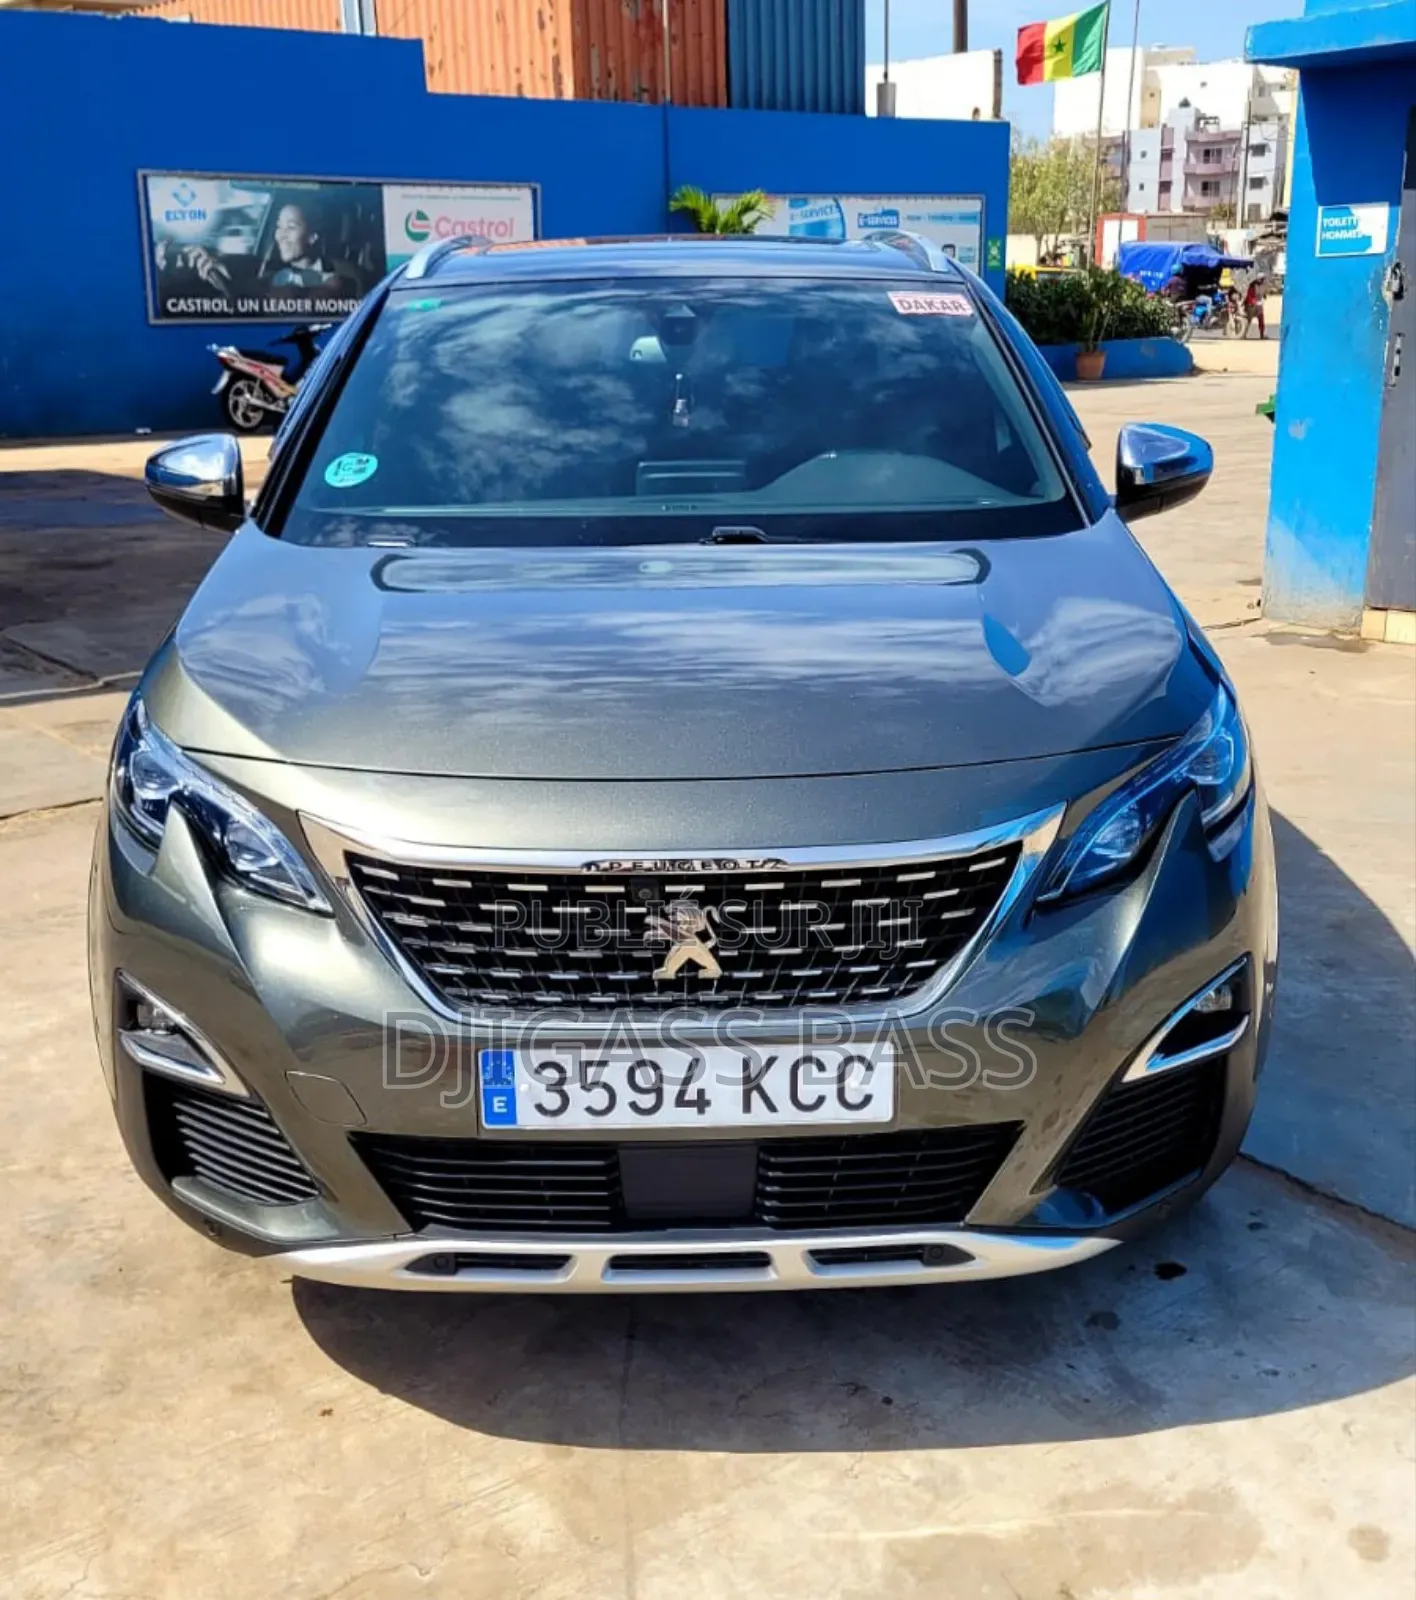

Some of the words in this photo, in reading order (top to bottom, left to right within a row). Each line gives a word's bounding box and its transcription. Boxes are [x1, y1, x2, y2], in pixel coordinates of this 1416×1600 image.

[435, 215, 514, 239] Castrol
[166, 297, 234, 316] CASTROL,
[237, 299, 259, 313] UN
[263, 299, 312, 313] LEADER
[898, 299, 967, 312] DAKAR
[533, 1058, 712, 1118] 3594
[741, 1054, 874, 1114] KCC
[492, 1097, 507, 1113] E
